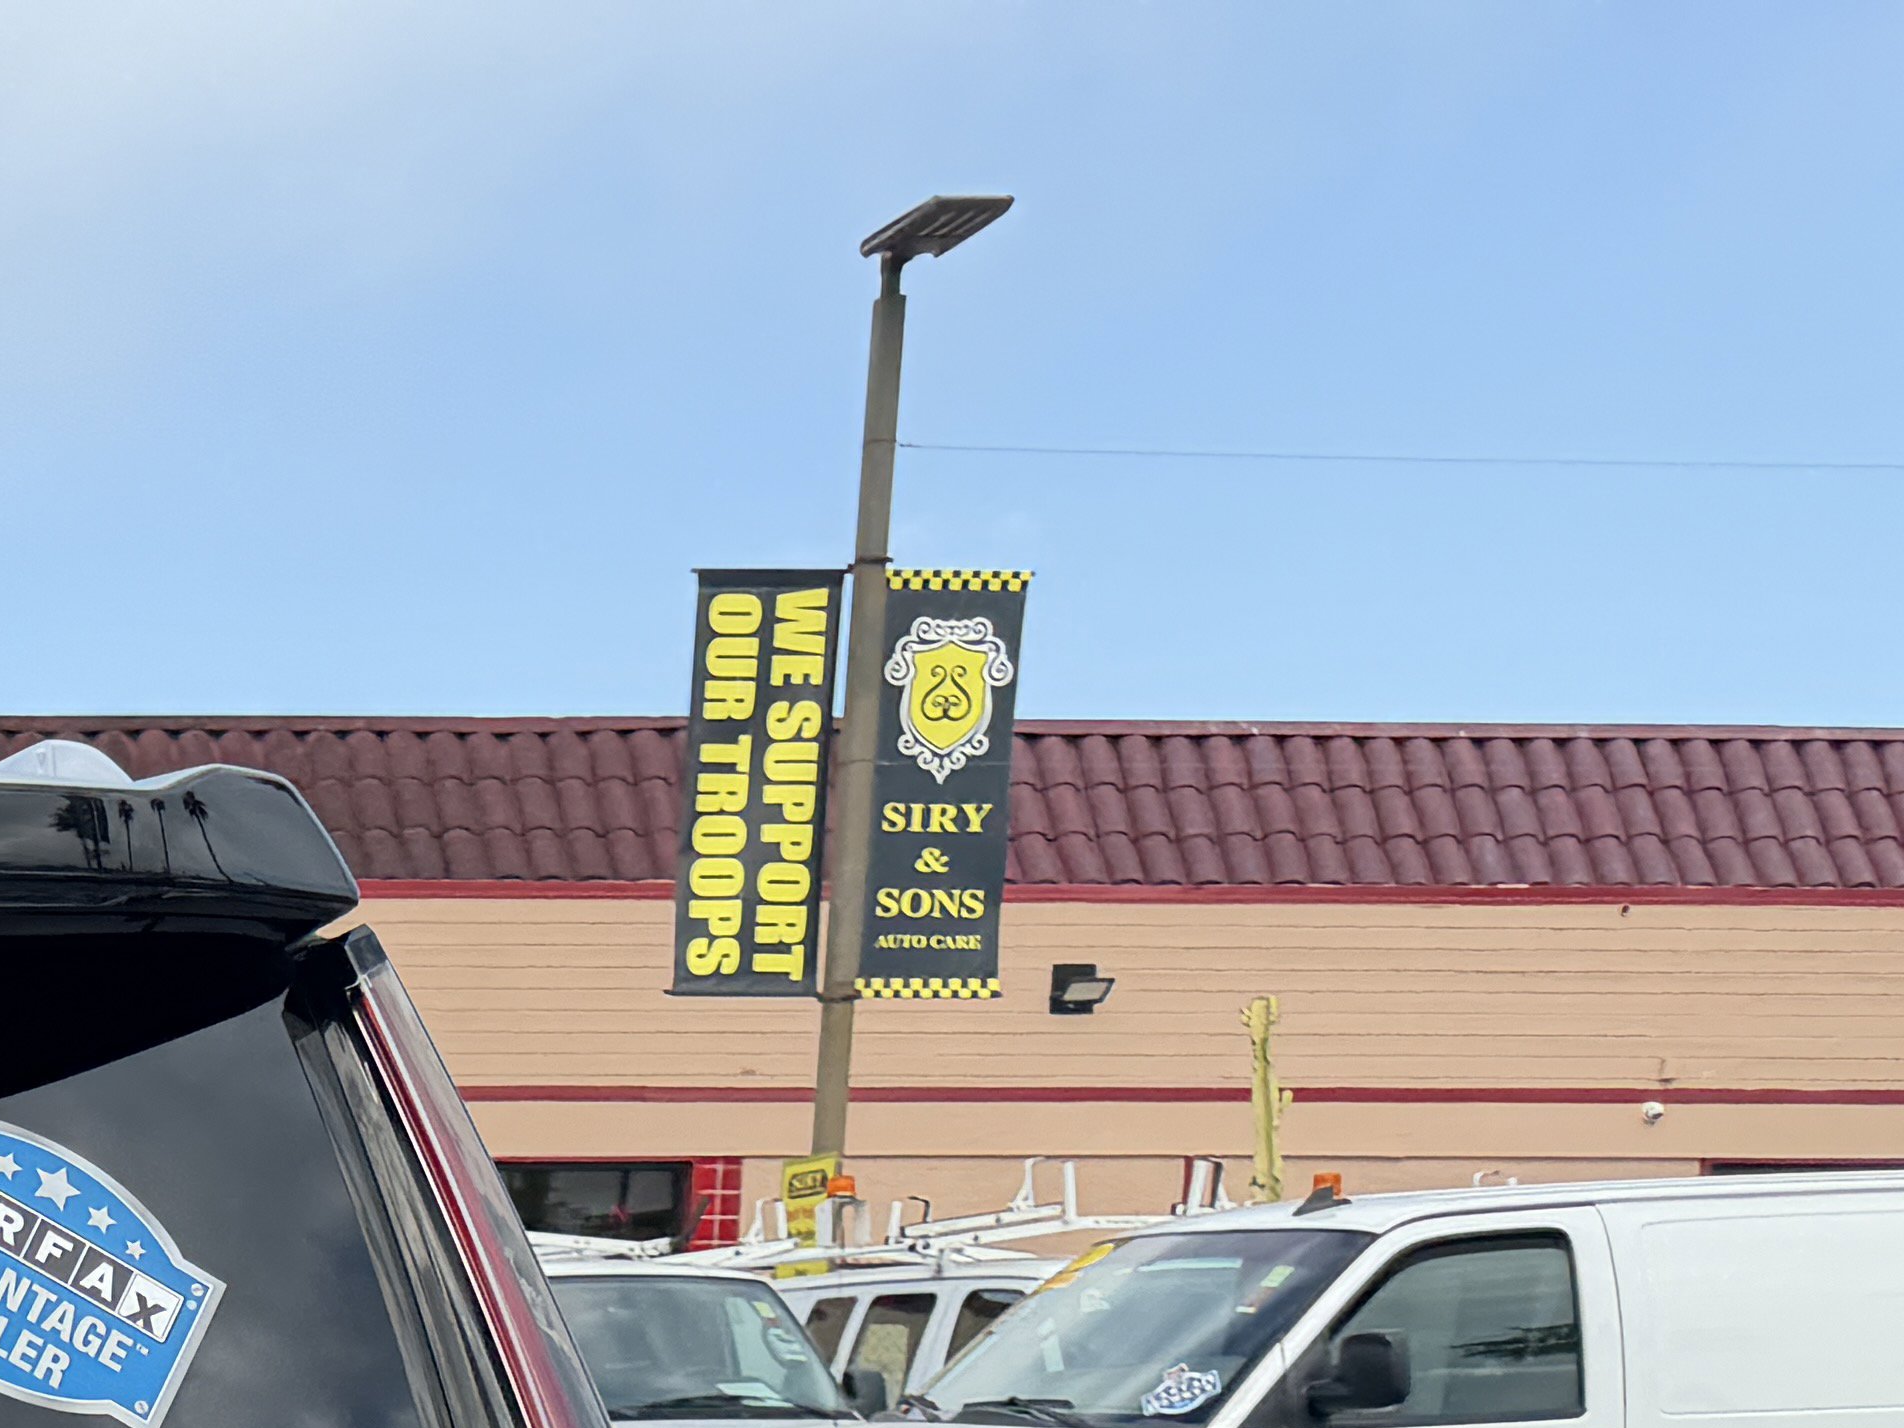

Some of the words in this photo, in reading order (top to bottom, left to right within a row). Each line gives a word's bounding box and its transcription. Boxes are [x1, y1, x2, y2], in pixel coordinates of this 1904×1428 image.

[703, 593, 763, 721] OUR
[769, 587, 829, 687] WE
[752, 700, 823, 981] SUPPORT
[881, 803, 993, 833] SIRY
[685, 734, 753, 977] TROOPS
[914, 847, 949, 874] &
[874, 887, 986, 919] SONS
[874, 933, 928, 950] AUTO
[929, 933, 982, 951] CARE
